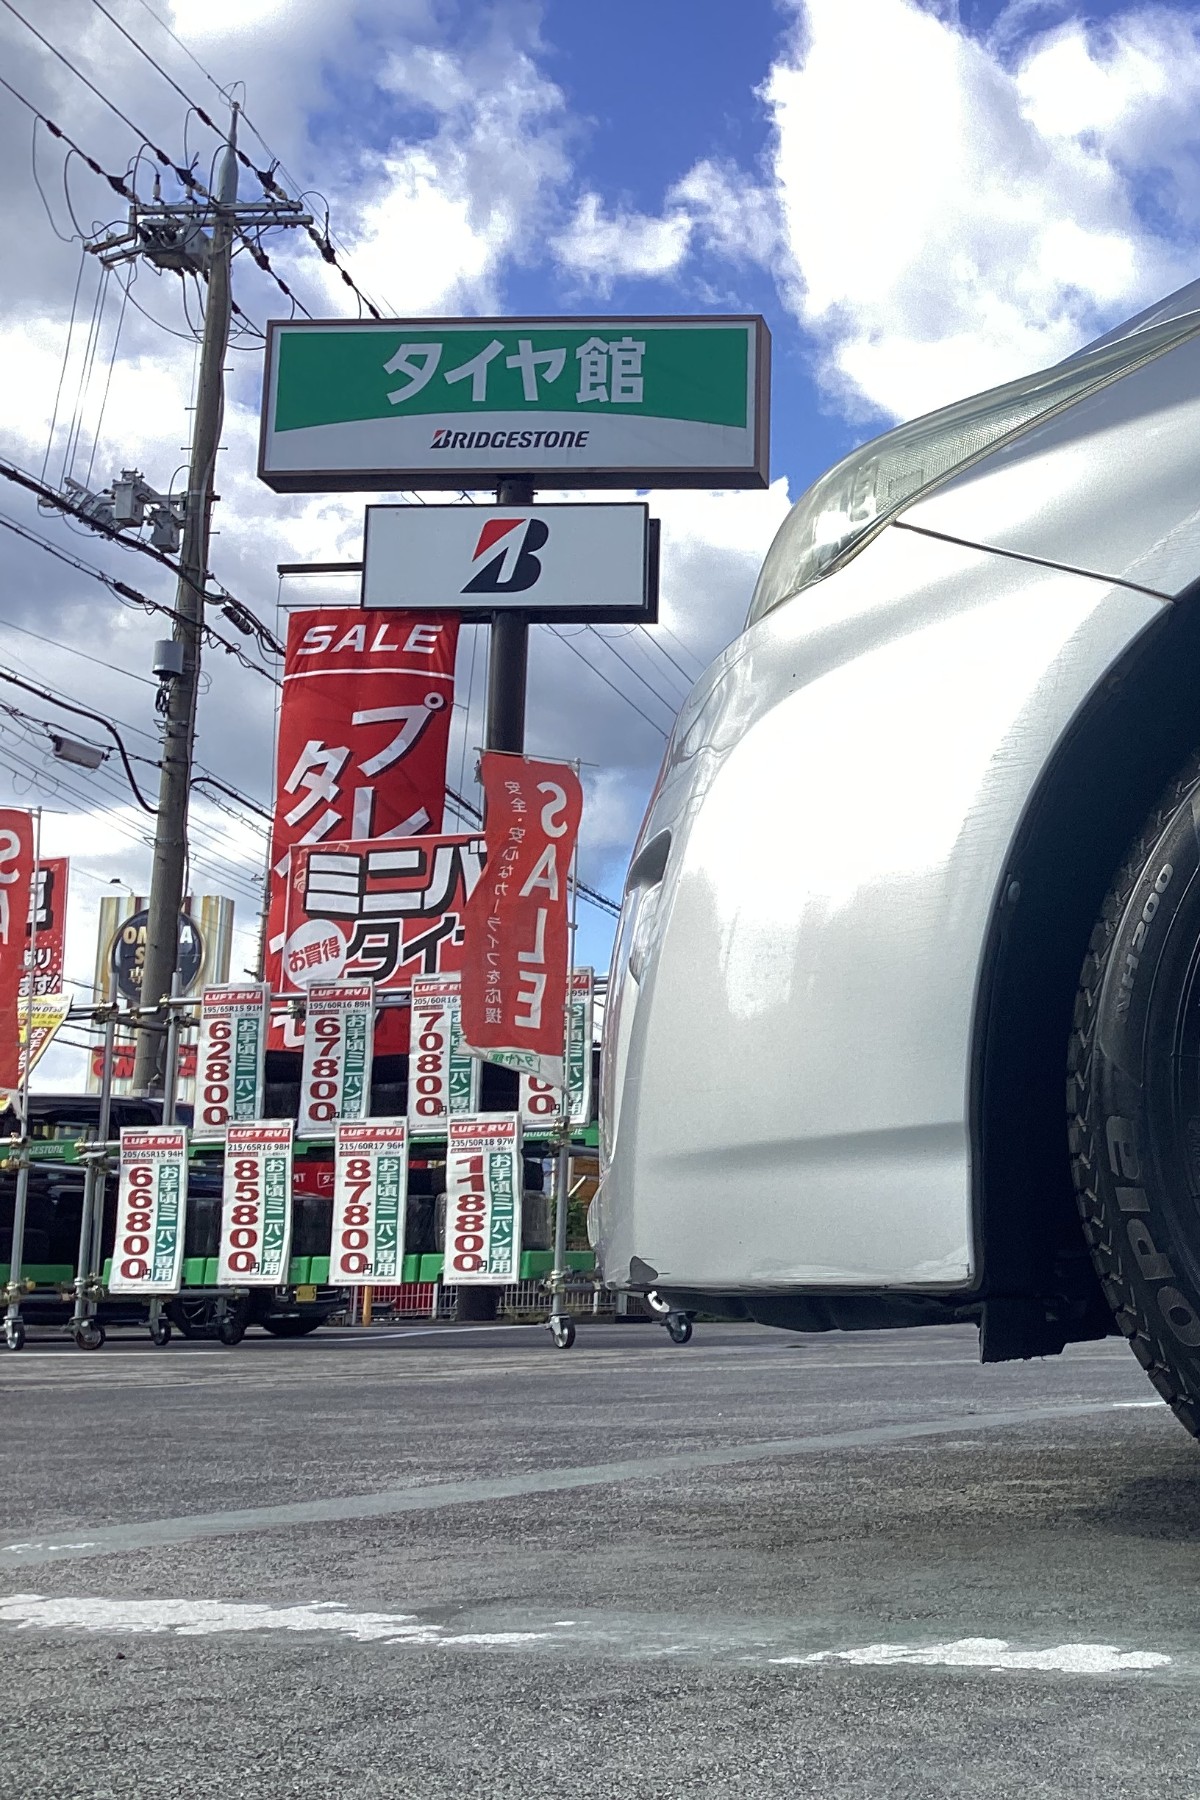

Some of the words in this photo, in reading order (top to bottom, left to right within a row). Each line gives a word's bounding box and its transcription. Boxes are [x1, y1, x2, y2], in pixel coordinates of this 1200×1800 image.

[383, 336, 646, 405] タイヤ館
[430, 429, 590, 449] BRIDGESTONE
[296, 624, 444, 654] SALE
[346, 914, 465, 982] タイ
[288, 935, 341, 973] お買得
[414, 984, 447, 992] LUFT
[205, 993, 237, 1001] LUFT
[311, 989, 343, 997] LUFT
[414, 996, 457, 1005] 205/60R16
[203, 1004, 245, 1013] 195/65R15
[246, 1004, 263, 1012] 91H
[309, 1001, 352, 1010] 195/60R16
[451, 1124, 487, 1133] LUFT
[229, 1129, 264, 1138] LUFT
[124, 1137, 156, 1145] LUFT
[451, 1138, 495, 1147] 235/50R18
[228, 1143, 273, 1151] 215/65R16
[340, 1142, 384, 1150] 215/60R17
[123, 1151, 166, 1159] 205/65R15
[263, 1159, 285, 1275] お手頃ミニバン専用
[376, 1158, 400, 1276] お手頃ミニバン専用
[490, 1154, 512, 1274] お手頃ミニバン専用
[154, 1166, 180, 1281] お手頃ミニバン専用
